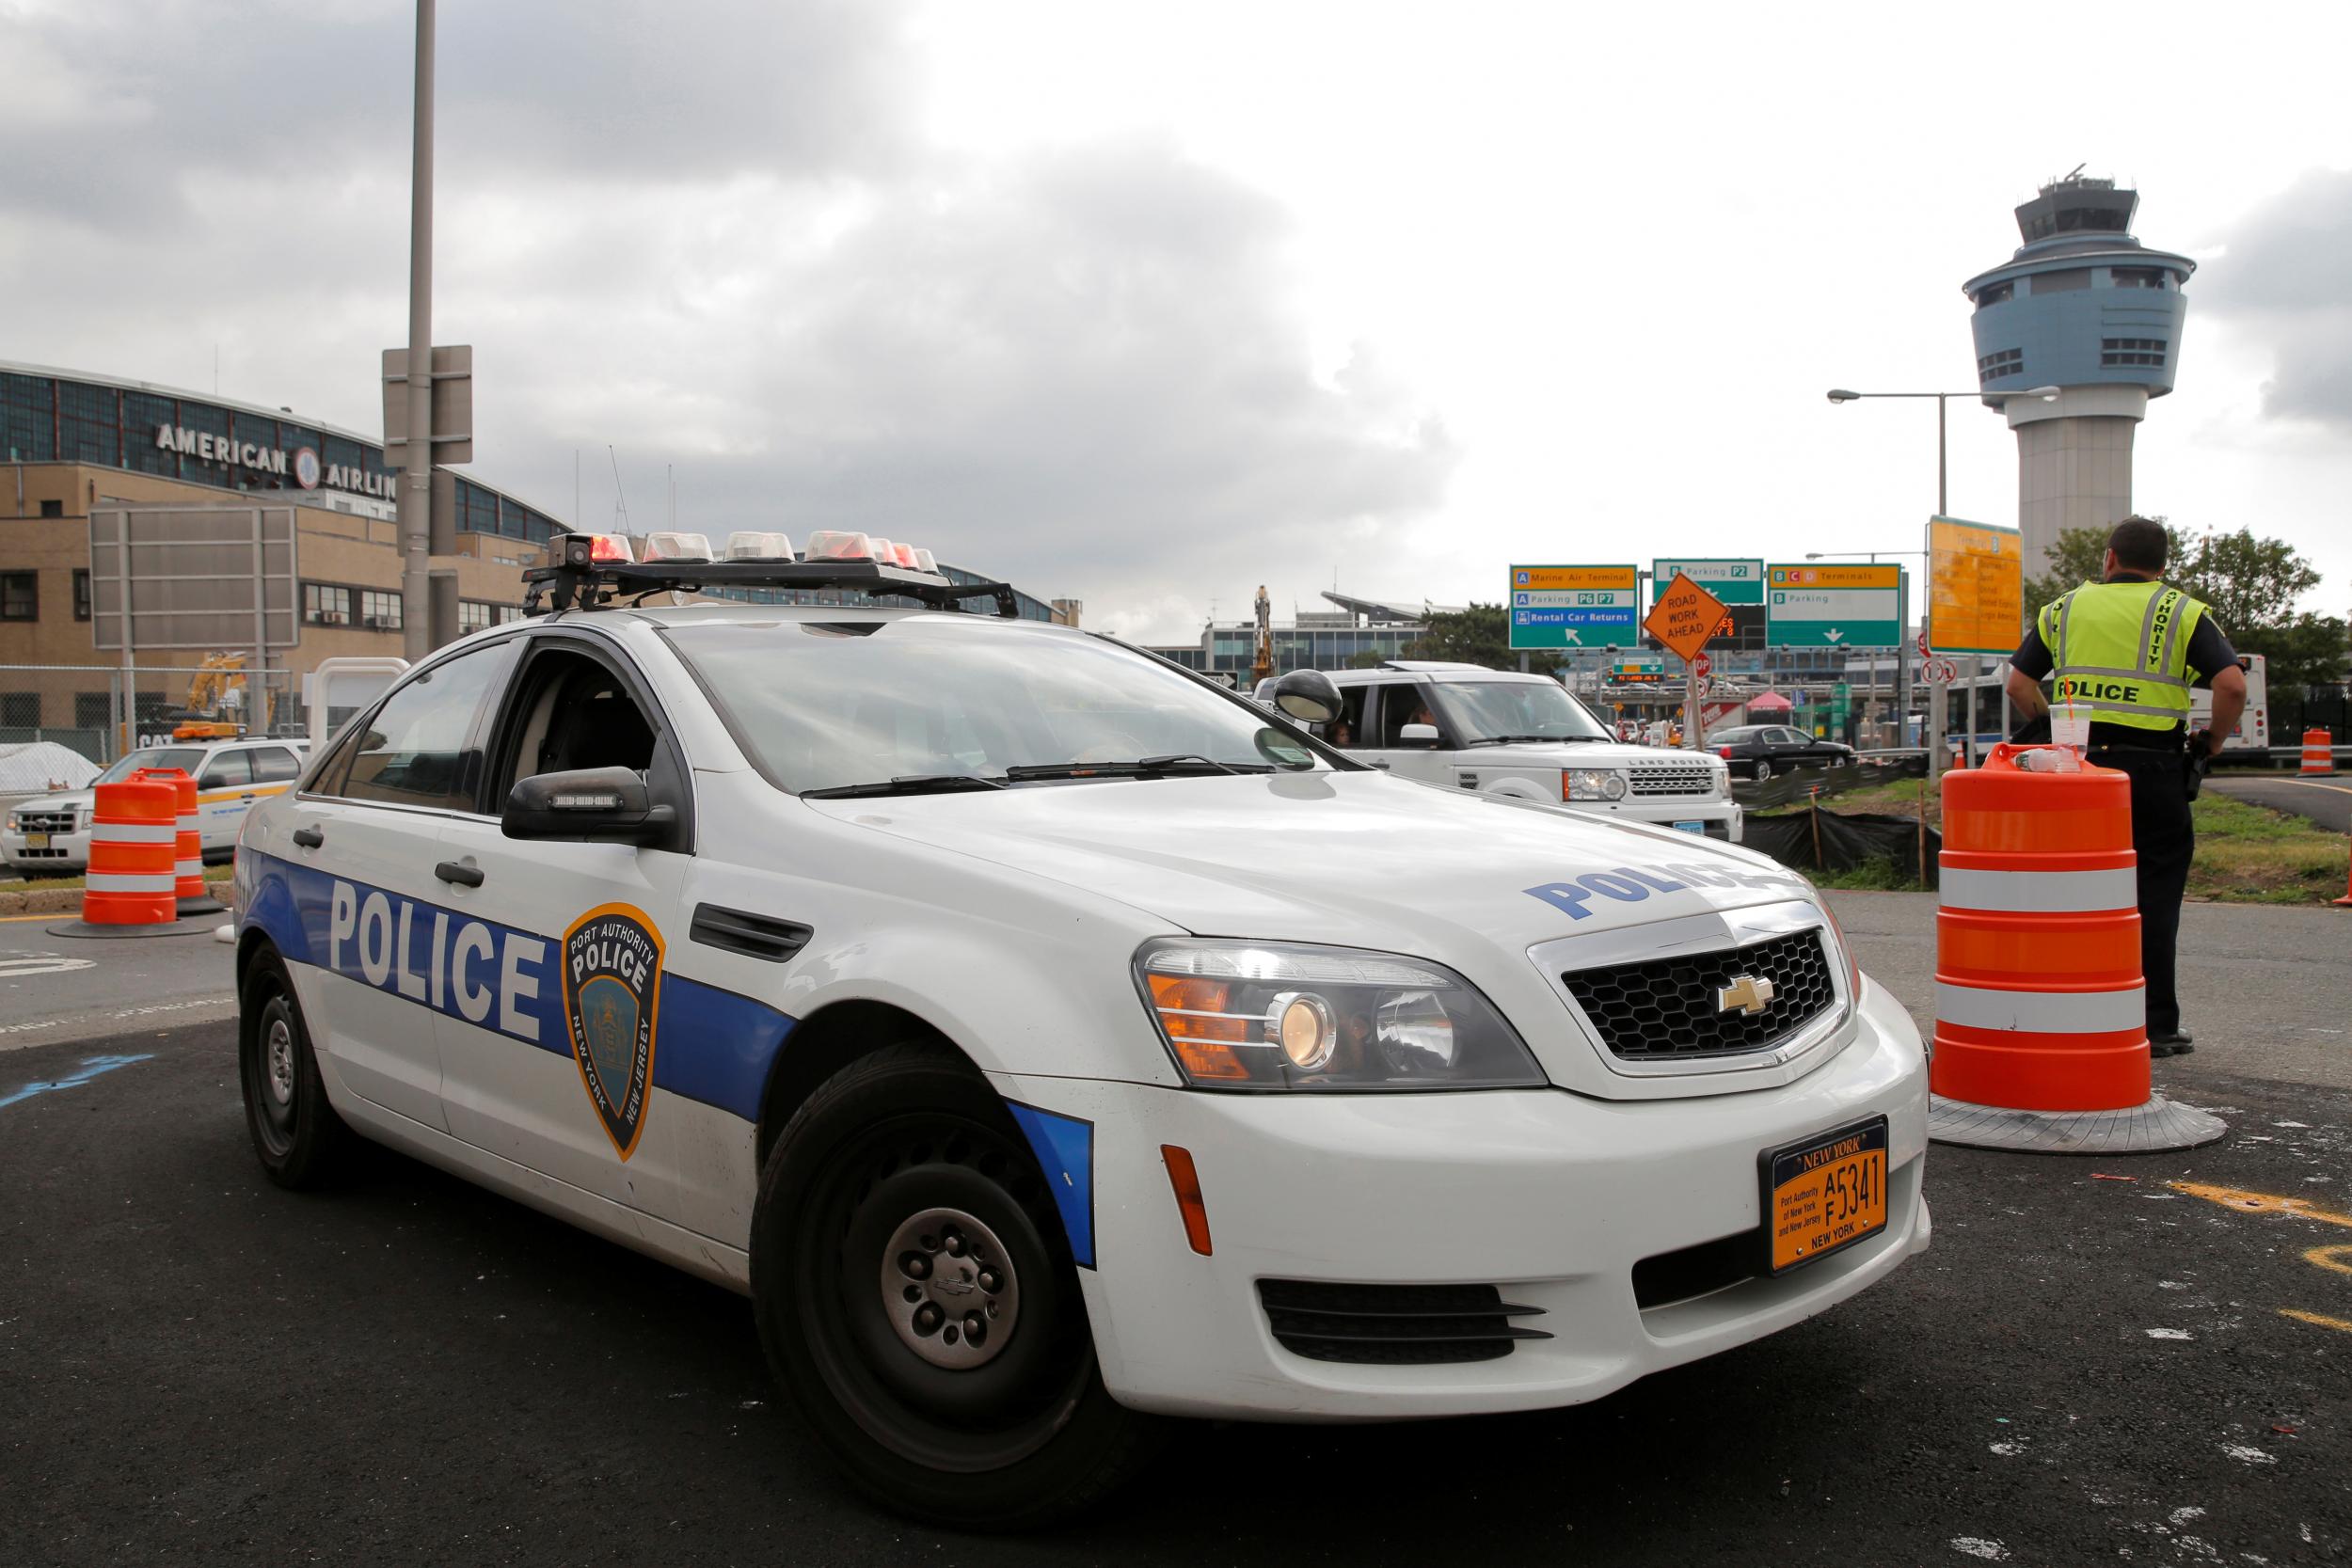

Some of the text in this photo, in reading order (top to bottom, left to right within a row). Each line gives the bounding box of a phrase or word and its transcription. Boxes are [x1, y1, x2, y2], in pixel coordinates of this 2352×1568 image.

[156, 423, 396, 499] AMERICAN AIRLIN
[1518, 573, 1528, 582] A
[1588, 573, 1628, 581] Terminal
[1687, 568, 1725, 577] Parking
[1733, 567, 1746, 577] P2
[1775, 572, 1784, 581] B
[1790, 572, 1799, 581] C
[1820, 572, 1873, 580] Terminals
[1518, 594, 1612, 604] A Parking P6 P7
[1668, 594, 1697, 609] ROAD
[1775, 594, 1828, 604] B Parking
[1531, 613, 1629, 622] Rental Car Returns
[1669, 610, 1698, 624] WORK
[1667, 623, 1704, 639] AHEAD
[2058, 680, 2139, 703] POLICE
[138, 734, 173, 749] CAT
[1521, 863, 1788, 920] POLICE
[570, 923, 654, 965] PORT AUTHORITY
[330, 879, 546, 1041] POLICE
[572, 942, 647, 994] POLICE
[573, 1015, 607, 1110] NEW YORK
[626, 1017, 649, 1126] NEW JERSEY
[1804, 1135, 1861, 1170] NEW YORK
[1781, 1187, 1819, 1207] Port Authority
[1783, 1202, 1816, 1221] of New York
[1778, 1214, 1821, 1237] and New Jersey
[1812, 1222, 1855, 1250] NEW YORK
